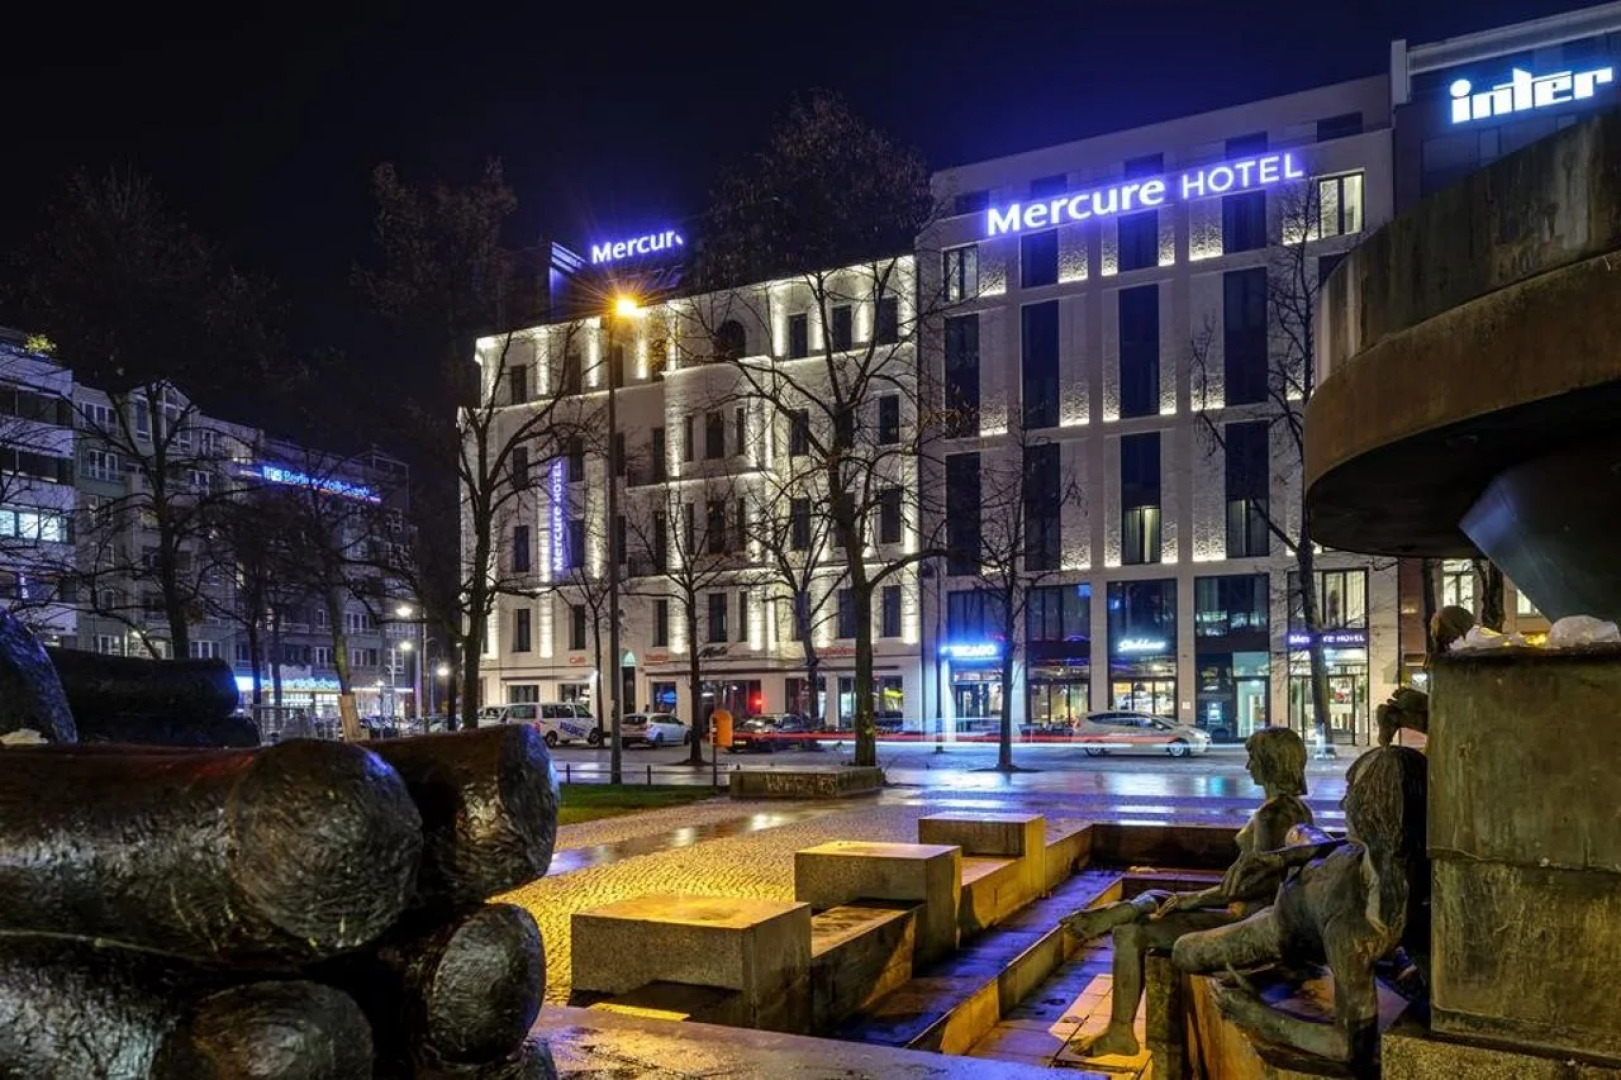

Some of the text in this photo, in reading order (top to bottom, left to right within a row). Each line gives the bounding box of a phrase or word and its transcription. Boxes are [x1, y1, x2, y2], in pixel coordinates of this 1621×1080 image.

[1449, 66, 1614, 125] inter
[986, 151, 1305, 237] Mercure HOTEL
